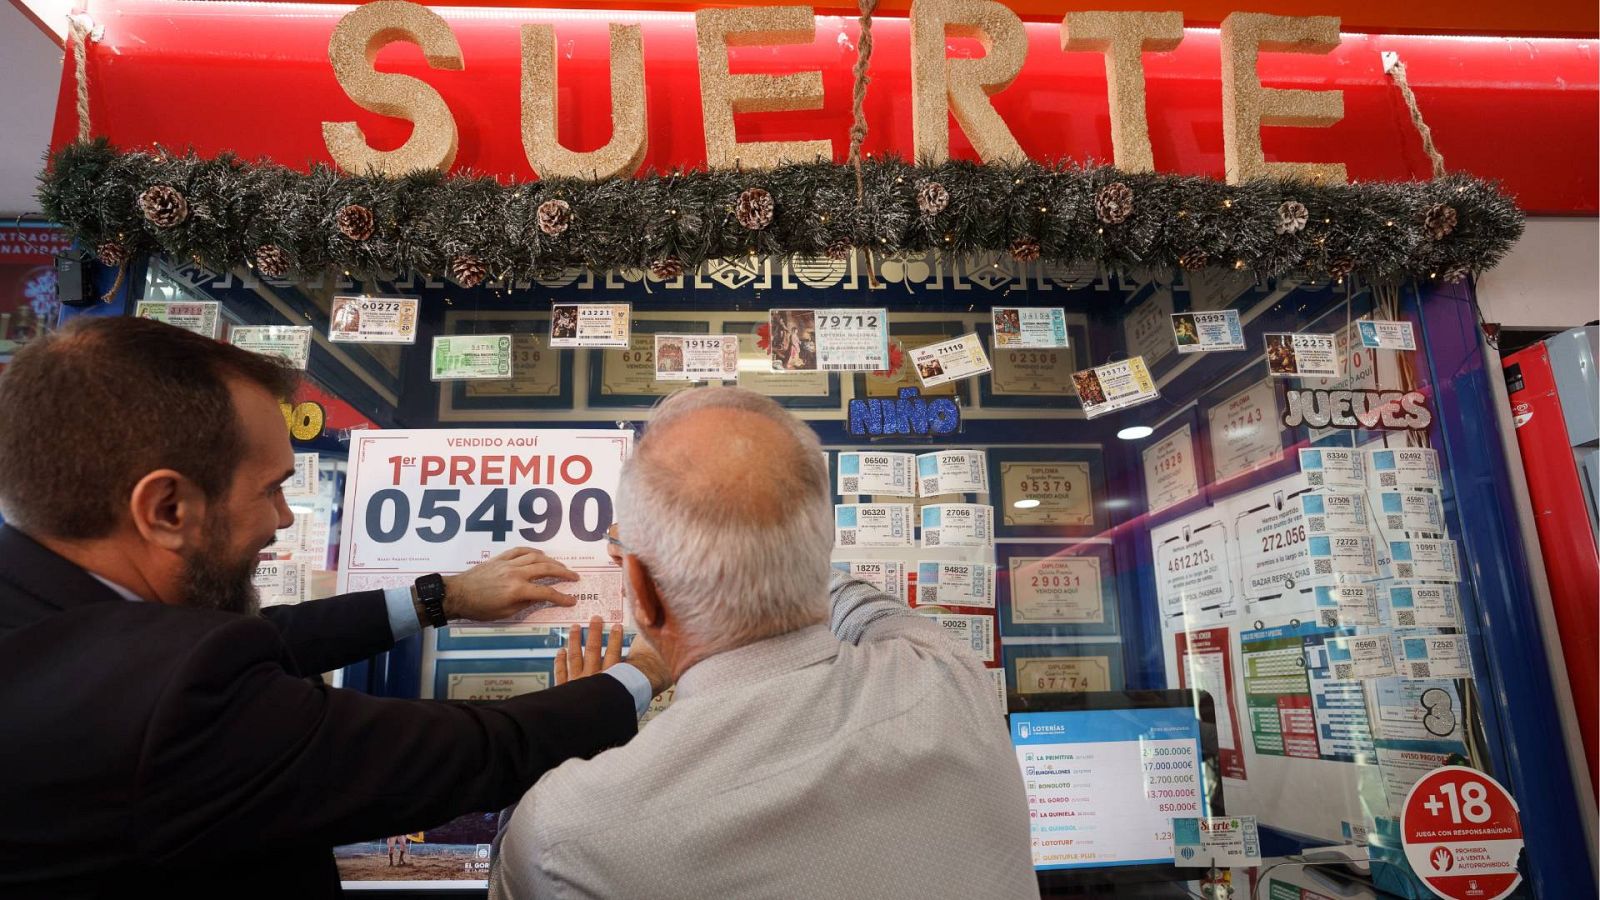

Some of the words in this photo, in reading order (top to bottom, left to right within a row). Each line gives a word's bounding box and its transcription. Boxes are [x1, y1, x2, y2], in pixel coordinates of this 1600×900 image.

[321, 0, 1347, 186] SUERTE
[361, 302, 400, 311] 60272
[817, 315, 878, 328] 79712
[1195, 314, 1225, 323] 04992
[685, 340, 720, 348] 19152
[1294, 338, 1333, 348] 22253
[937, 343, 964, 354] 71119
[849, 387, 960, 436] NIÑO
[1283, 389, 1432, 430] JUEVES
[447, 437, 503, 447] VENDIDO
[506, 435, 539, 449] AQUÍ
[864, 456, 889, 464] 06500
[942, 456, 965, 464] 27066
[1399, 452, 1422, 460] 02492
[419, 454, 593, 485] PREMIO
[1020, 481, 1072, 492] 95379
[365, 488, 614, 543] 05490
[1262, 525, 1306, 552] 272.056
[1335, 538, 1358, 546] 72723
[1416, 543, 1437, 551] 10991
[856, 564, 881, 572] 18275
[944, 566, 969, 574] 94832
[1031, 576, 1080, 587] 29031
[1251, 577, 1271, 587] BAZAR
[1272, 571, 1295, 583] REPSOL
[1341, 588, 1364, 596] 52122
[942, 620, 967, 628] 50025
[1037, 677, 1088, 689] 67774
[1032, 724, 1065, 732] LOTERÍAS
[1400, 752, 1419, 760] AVISO
[1144, 761, 1192, 771] 17.000.000€
[1149, 775, 1194, 785] 2.700.000€
[1159, 803, 1197, 812] 850.000€
[1423, 781, 1492, 824] +18
[1415, 829, 1437, 837] JUEGA
[1453, 827, 1513, 836] RESPONSABILIDAD
